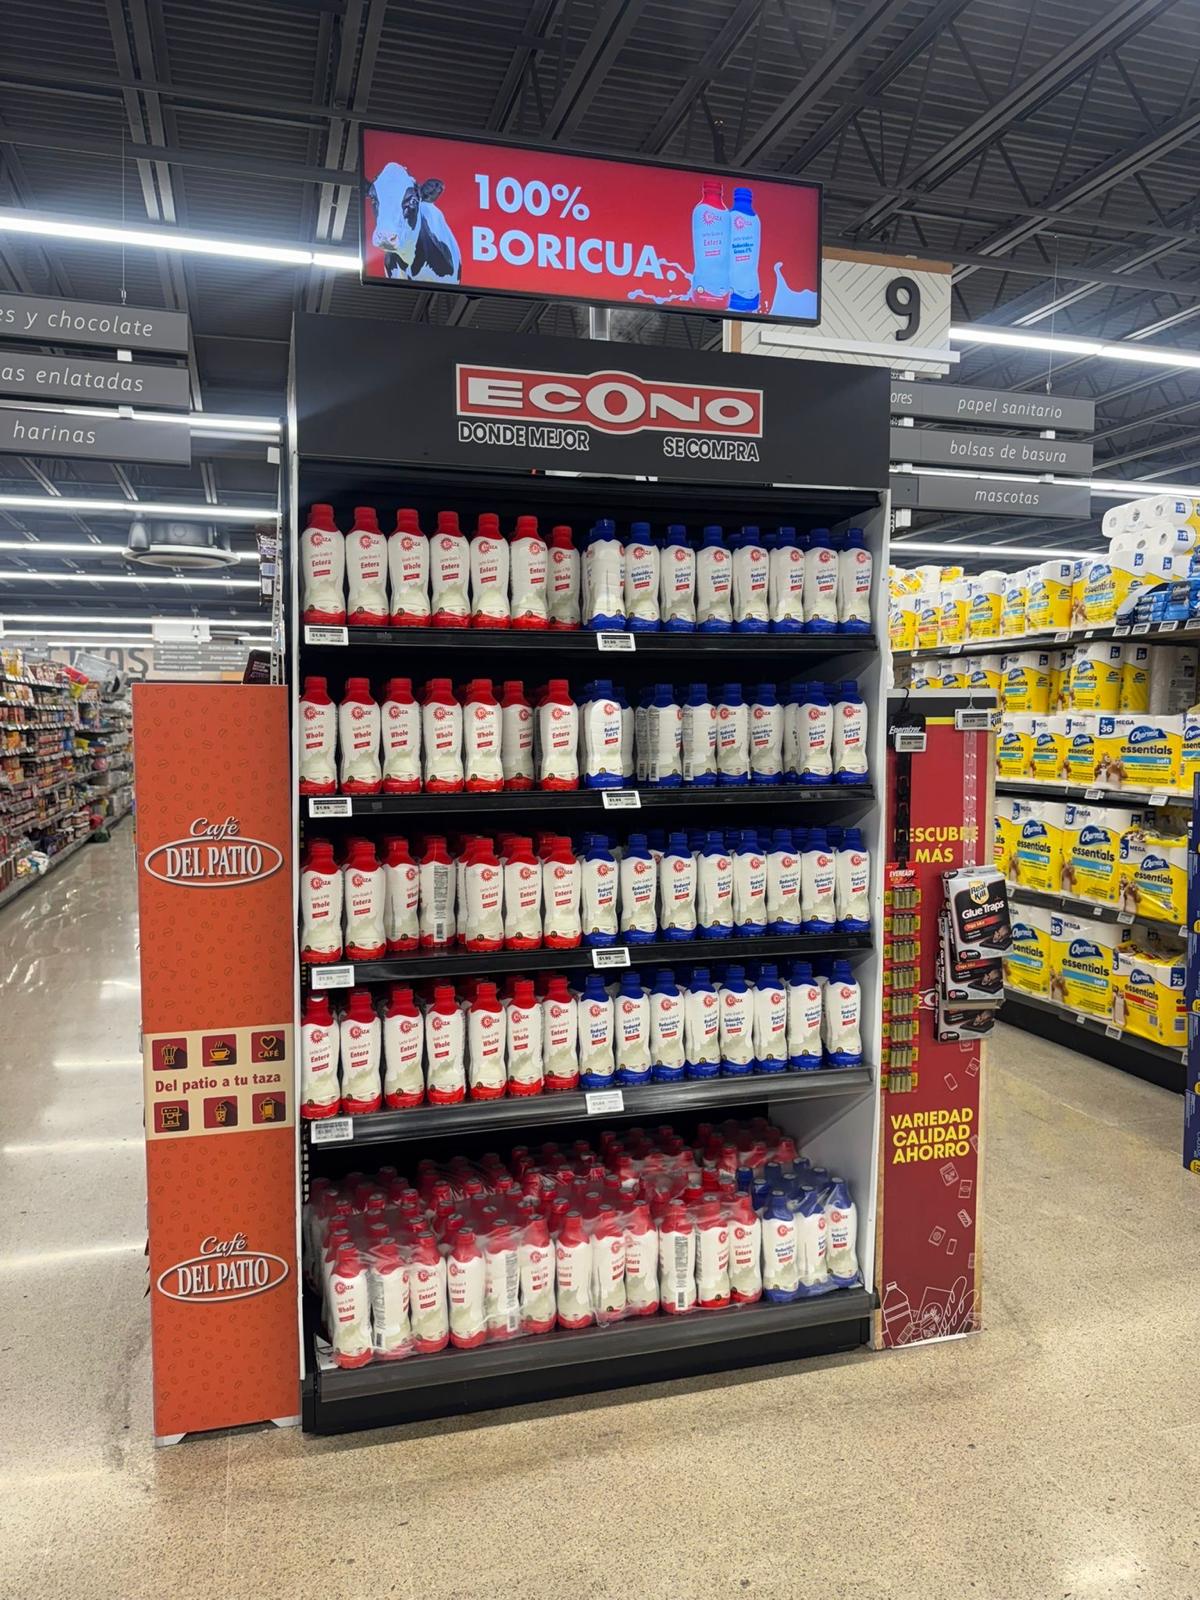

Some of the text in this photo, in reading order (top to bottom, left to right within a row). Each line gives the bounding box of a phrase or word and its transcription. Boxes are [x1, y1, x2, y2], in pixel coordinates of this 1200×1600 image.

[475, 174, 590, 221] 100%
[472, 227, 676, 281] BORICUA.
[886, 276, 920, 341] 9
[24, 312, 38, 329] y
[48, 311, 153, 337] chocolate
[36, 368, 143, 392] enlatadas
[468, 376, 754, 426] ECONO
[958, 398, 1062, 419] papel sanitario
[14, 420, 96, 443] harinas
[458, 421, 589, 451] DONDE MEJOR
[664, 437, 759, 462] SE COMPRA
[950, 441, 1066, 463] bolsas de basura
[975, 489, 1039, 505] mascotas
[1131, 730, 1160, 741] Charmin
[1120, 746, 1172, 755] essentials
[190, 816, 239, 840] Café
[915, 843, 954, 863] MÁS
[1017, 840, 1051, 853] essentials
[1072, 846, 1115, 862] essentials
[166, 845, 262, 877] DEL PATIO
[1099, 864, 1111, 872] soft
[970, 884, 985, 895] Real
[1134, 872, 1173, 885] essentials
[962, 900, 1004, 919] Glue Traps
[1062, 959, 1110, 976] essentials
[1125, 984, 1159, 1001] essentials
[1173, 978, 1183, 986] 72
[258, 1050, 279, 1058] CAFÉ
[155, 1073, 281, 1094] Del patio a tu taza
[891, 1107, 973, 1129] VARIEDAD
[893, 1125, 971, 1147] CALIDAD
[893, 1141, 970, 1164] AHORRO
[200, 1232, 247, 1256] Café
[178, 1258, 269, 1295] DEL PATIO
